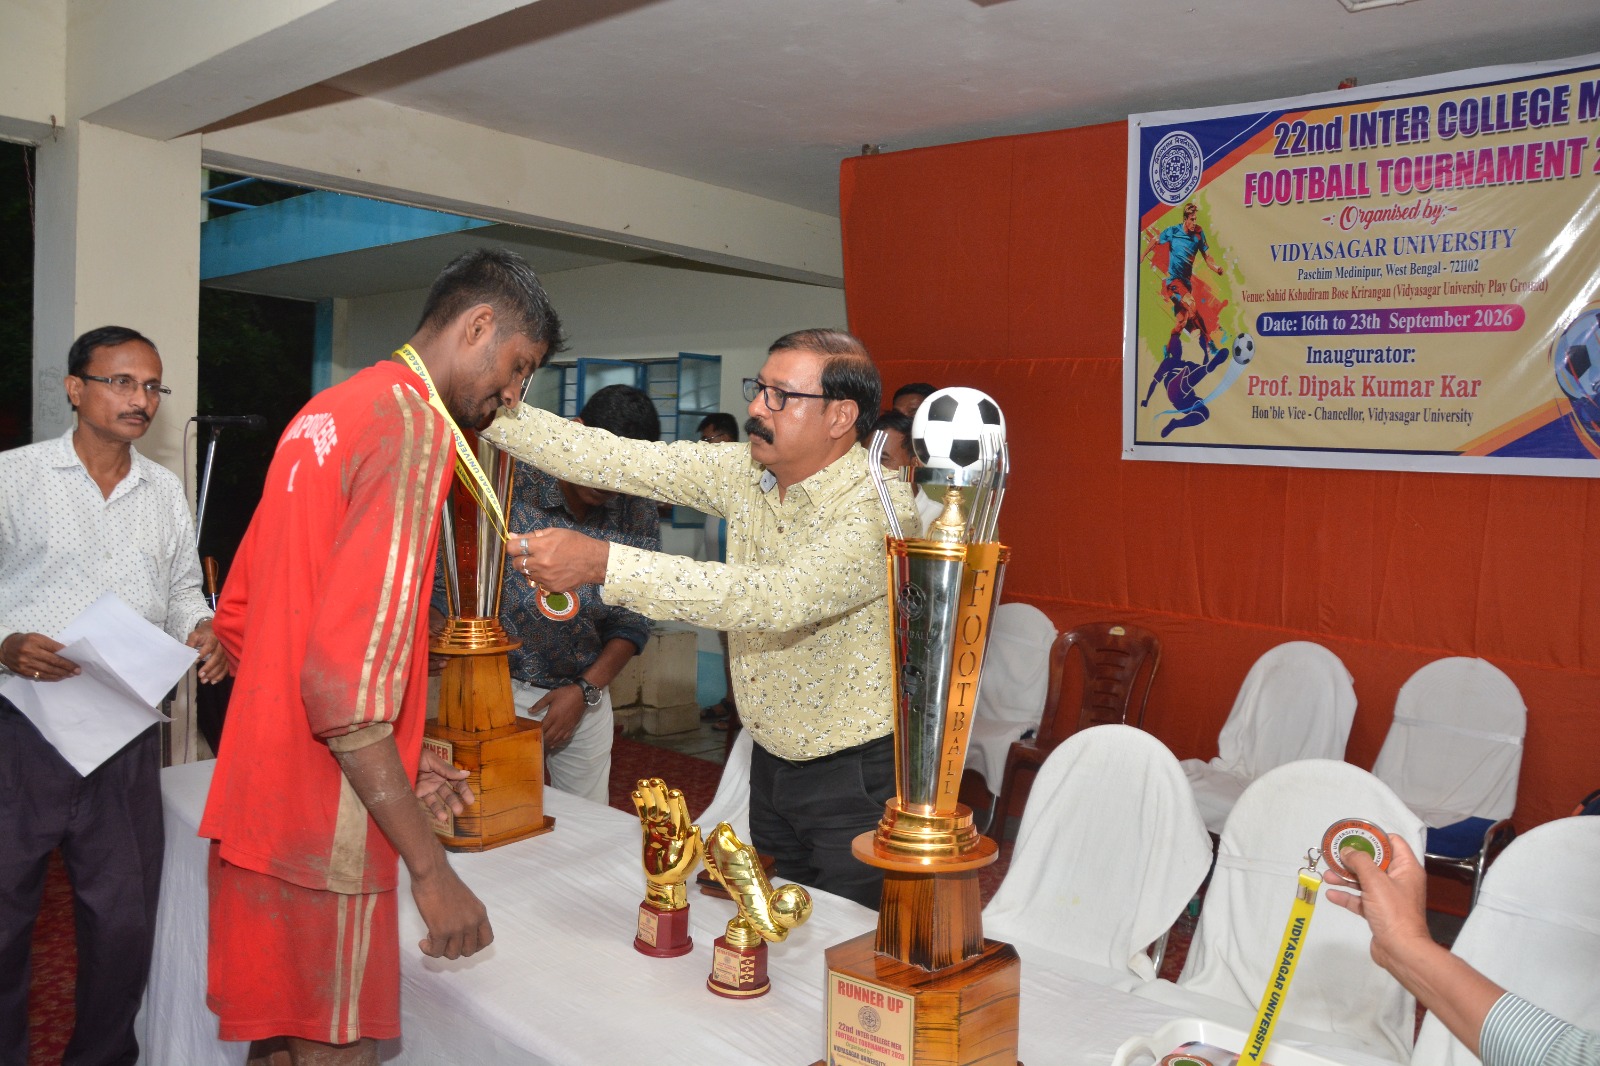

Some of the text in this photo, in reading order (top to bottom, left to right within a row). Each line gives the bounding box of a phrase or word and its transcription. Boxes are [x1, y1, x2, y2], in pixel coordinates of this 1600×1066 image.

[1274, 116, 1342, 157] 22nd
[1349, 105, 1430, 149] INTER
[1437, 87, 1570, 139] COLLEGE
[1244, 161, 1371, 207] FOOTBALL
[1376, 136, 1588, 195] TOURNAMENT
[1339, 199, 1421, 231] Organised
[1269, 228, 1517, 262] VIDYASAGAR UNIVERSITY
[1297, 267, 1333, 281] Paschim
[1335, 265, 1383, 281] Medinipur,
[1385, 263, 1407, 277] West
[1410, 261, 1441, 278] Bengal
[1450, 258, 1479, 273] 721102
[1241, 277, 1549, 303] Venue: Sahid Kshudiram Bose Krirangan (Vidyasagar University Play Ground)
[1262, 308, 1513, 333] Date: 16th to 23th September 2026
[1306, 345, 1416, 368] Inaugurator:
[1247, 374, 1482, 401] Prof. Dipak Kumar Kar
[1251, 405, 1285, 420] Hon'ble
[1288, 406, 1306, 420] Vice
[1314, 406, 1365, 423] Chancellor,
[1368, 407, 1420, 425] Vidyasagar
[1423, 407, 1474, 426] University
[944, 569, 989, 795] FOOTBALL
[837, 979, 904, 1014] RUNNER UP
[1248, 917, 1306, 1061] VIDYASAGAR UNIVERSITY
[835, 1030, 858, 1044] FOOTBALL
[858, 1038, 891, 1056] TOURNAMENT
[838, 1021, 902, 1051] 22nd INTER COLLEGE MEN
